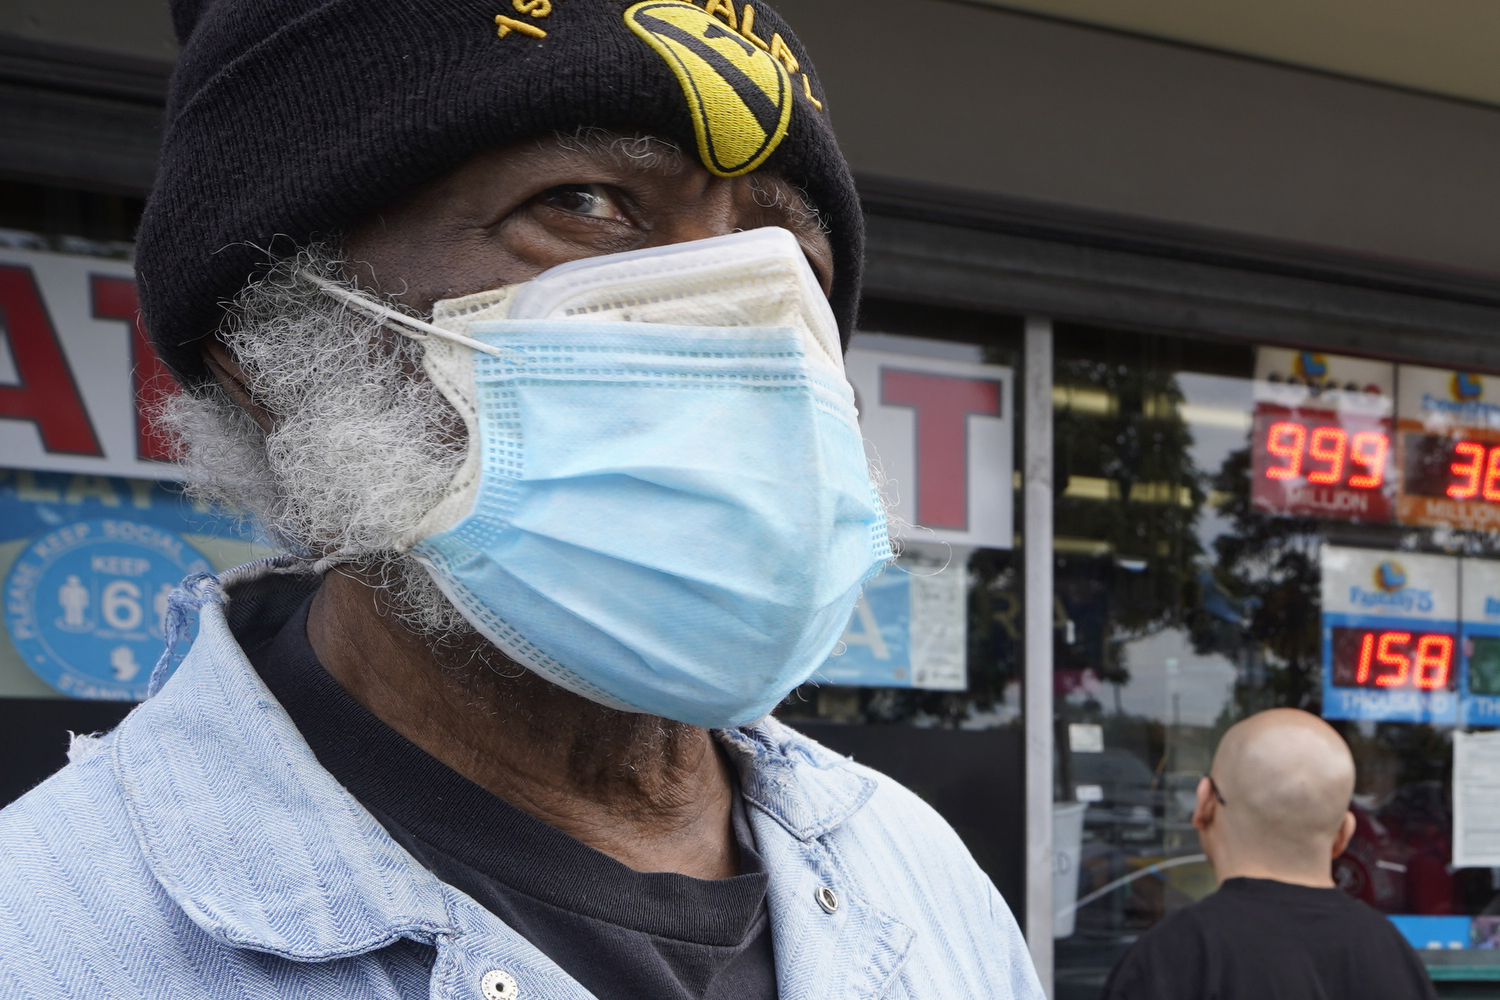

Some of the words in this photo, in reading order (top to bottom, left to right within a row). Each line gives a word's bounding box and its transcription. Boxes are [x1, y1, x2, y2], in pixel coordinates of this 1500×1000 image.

[1266, 421, 1389, 489] 999
[1285, 488, 1368, 514] MILLION
[32, 522, 91, 559] KEEP
[101, 519, 184, 559] SOCIAL
[91, 553, 152, 577] KEEP
[102, 579, 143, 631] 6
[1356, 631, 1453, 690] 158
[1339, 690, 1449, 716] THOUSAND
